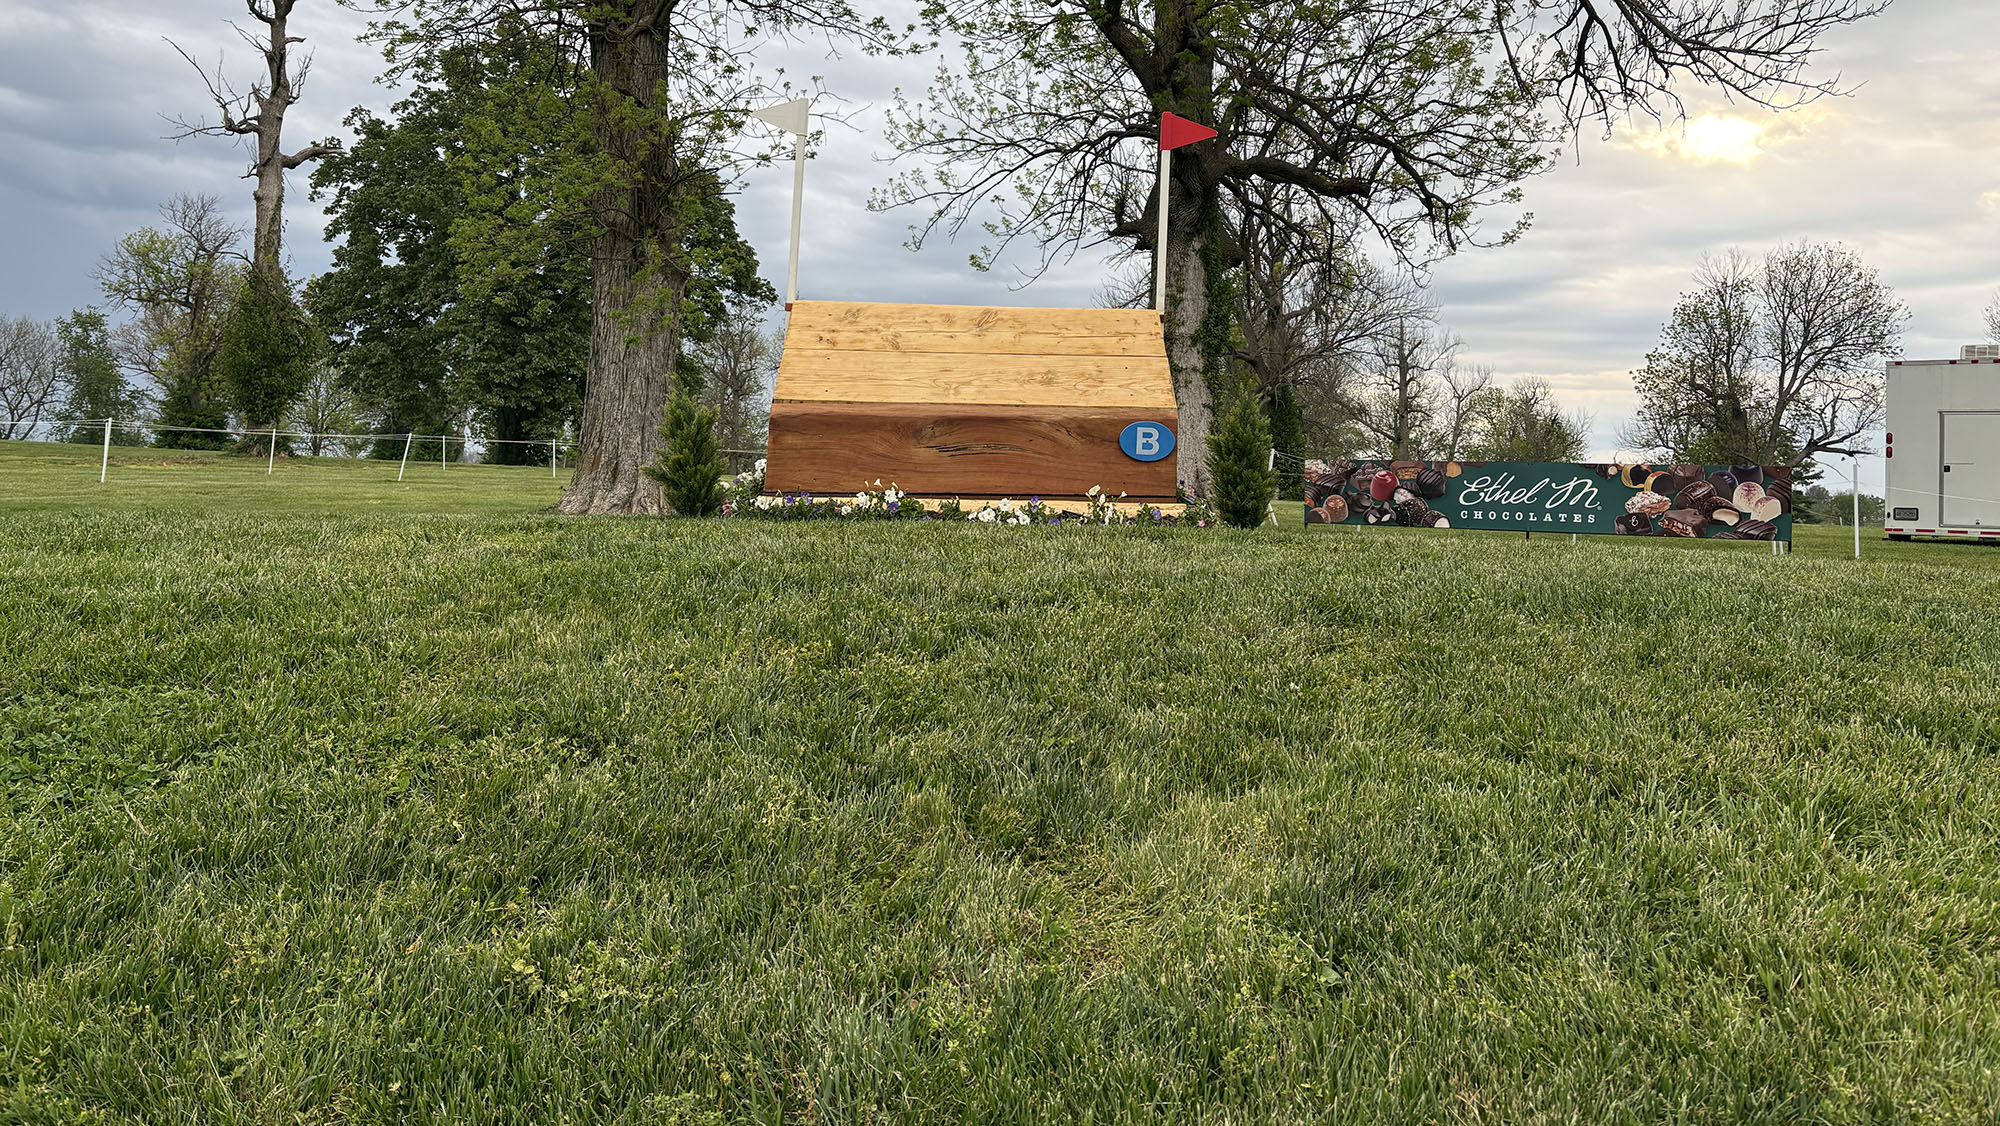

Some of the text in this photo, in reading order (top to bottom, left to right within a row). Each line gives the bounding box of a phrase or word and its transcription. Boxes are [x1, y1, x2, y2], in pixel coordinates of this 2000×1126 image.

[1136, 427, 1160, 455] B
[1458, 472, 1550, 506] Ethel
[1460, 510, 1596, 524] CHOCOLATES
